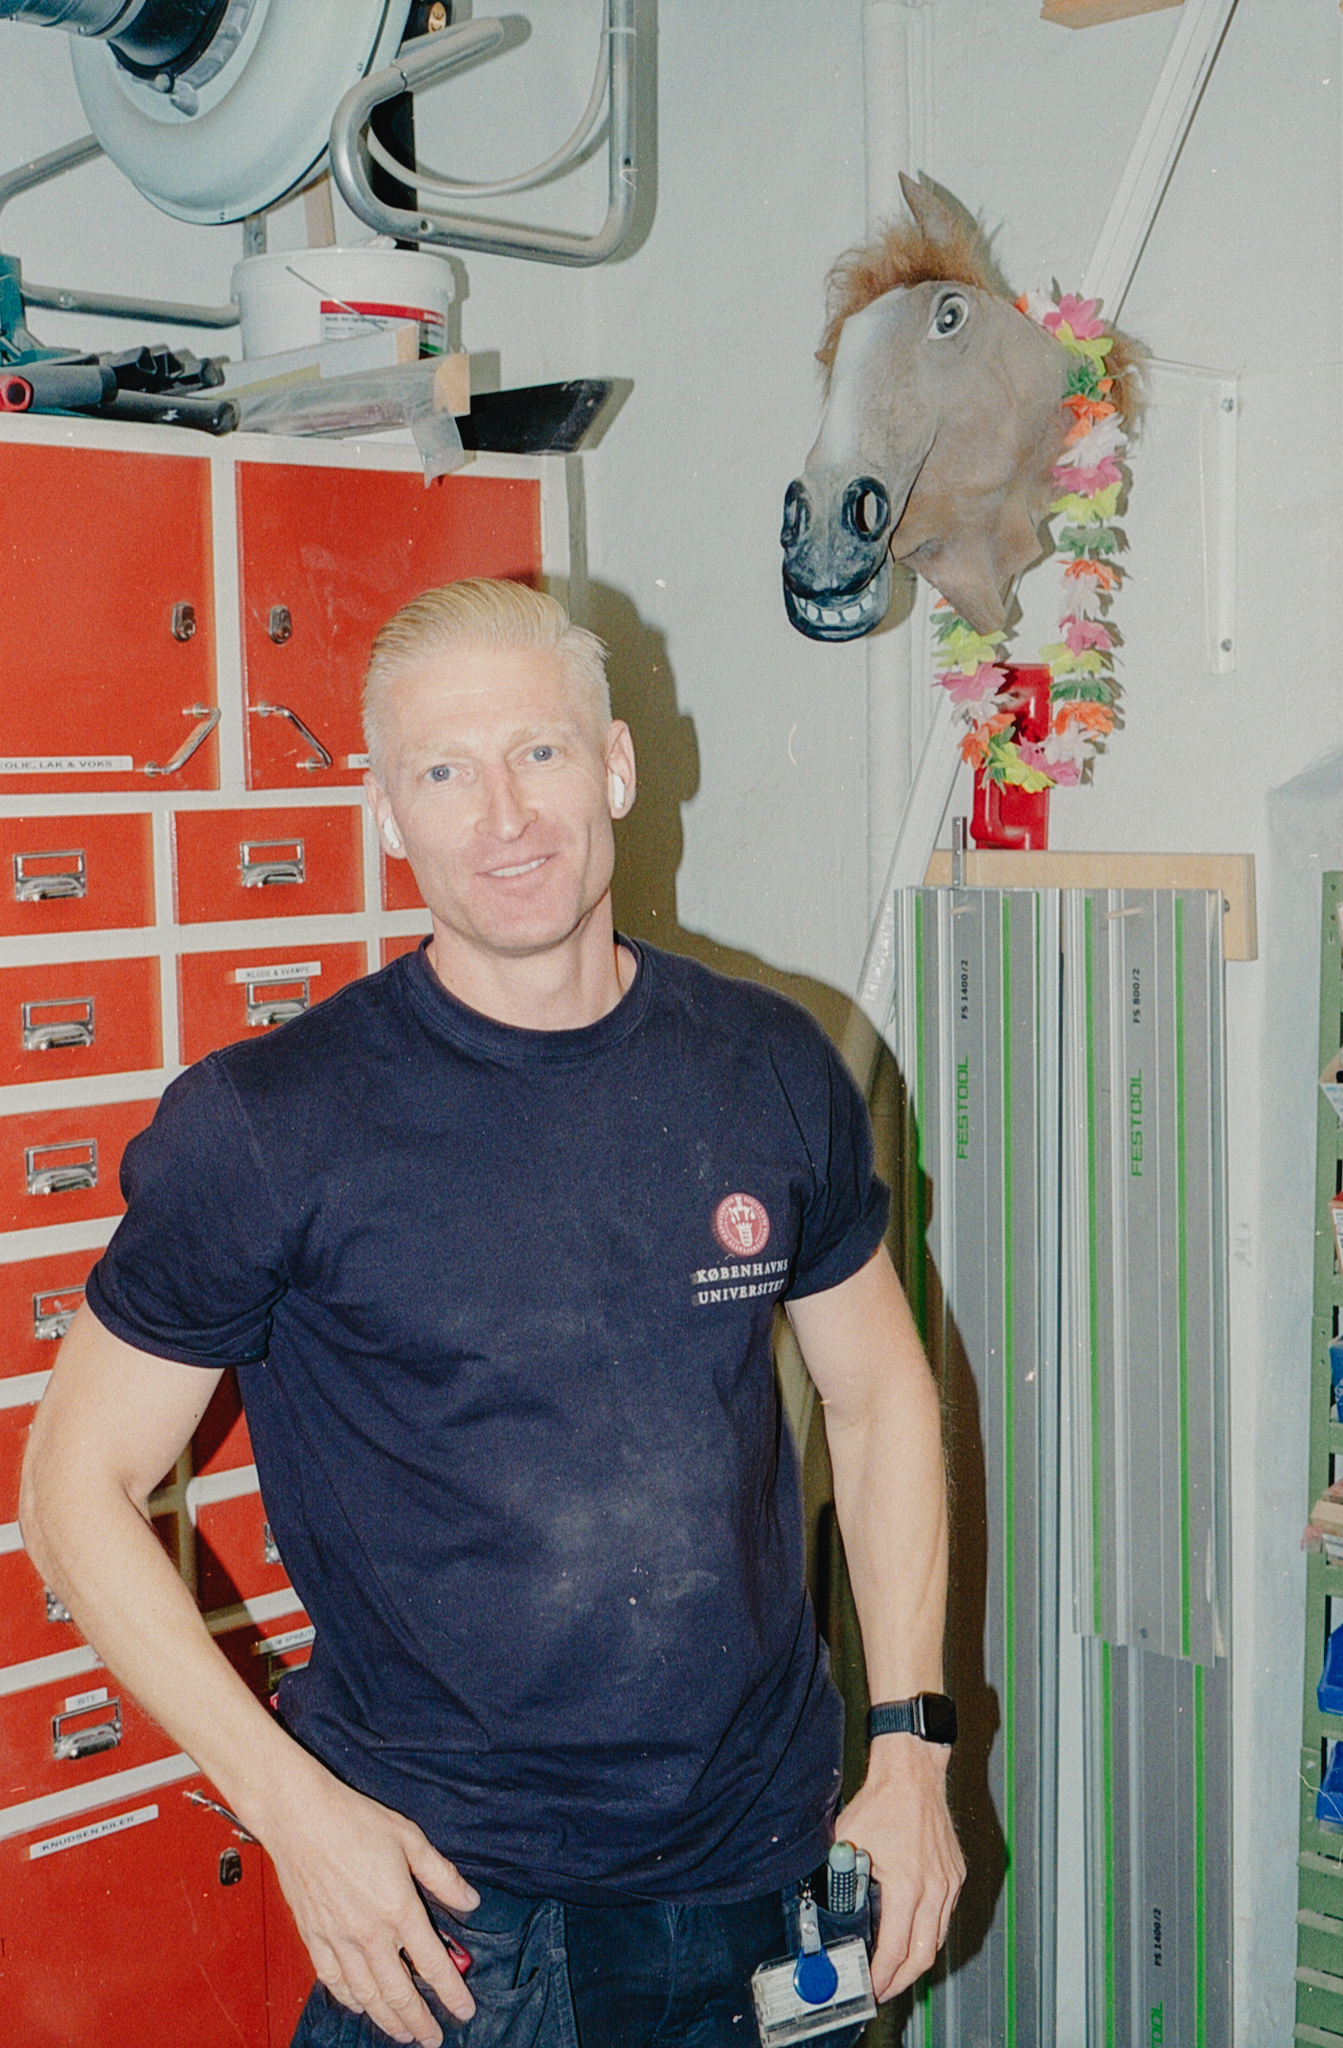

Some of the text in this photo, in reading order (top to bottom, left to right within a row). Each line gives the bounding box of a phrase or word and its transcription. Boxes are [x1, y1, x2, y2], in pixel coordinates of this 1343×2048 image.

[40, 761, 63, 769] LAK
[79, 760, 113, 768] VOKS
[246, 970, 271, 979] KLUDE
[280, 966, 310, 976] SVAMPE
[960, 959, 969, 1020] FS 1400/2
[1132, 968, 1141, 1024] FS 800/2
[957, 1055, 969, 1160] FESTOOL
[1130, 1067, 1143, 1177] FESTOOL
[696, 1258, 788, 1284] KØBENHAVNS
[697, 1278, 785, 1305] UNIVERSITET
[42, 1815, 135, 1851] KNUDSEN KILER
[1153, 1907, 1162, 1967] FS 1400/2
[1150, 2001, 1164, 2048] OOL
